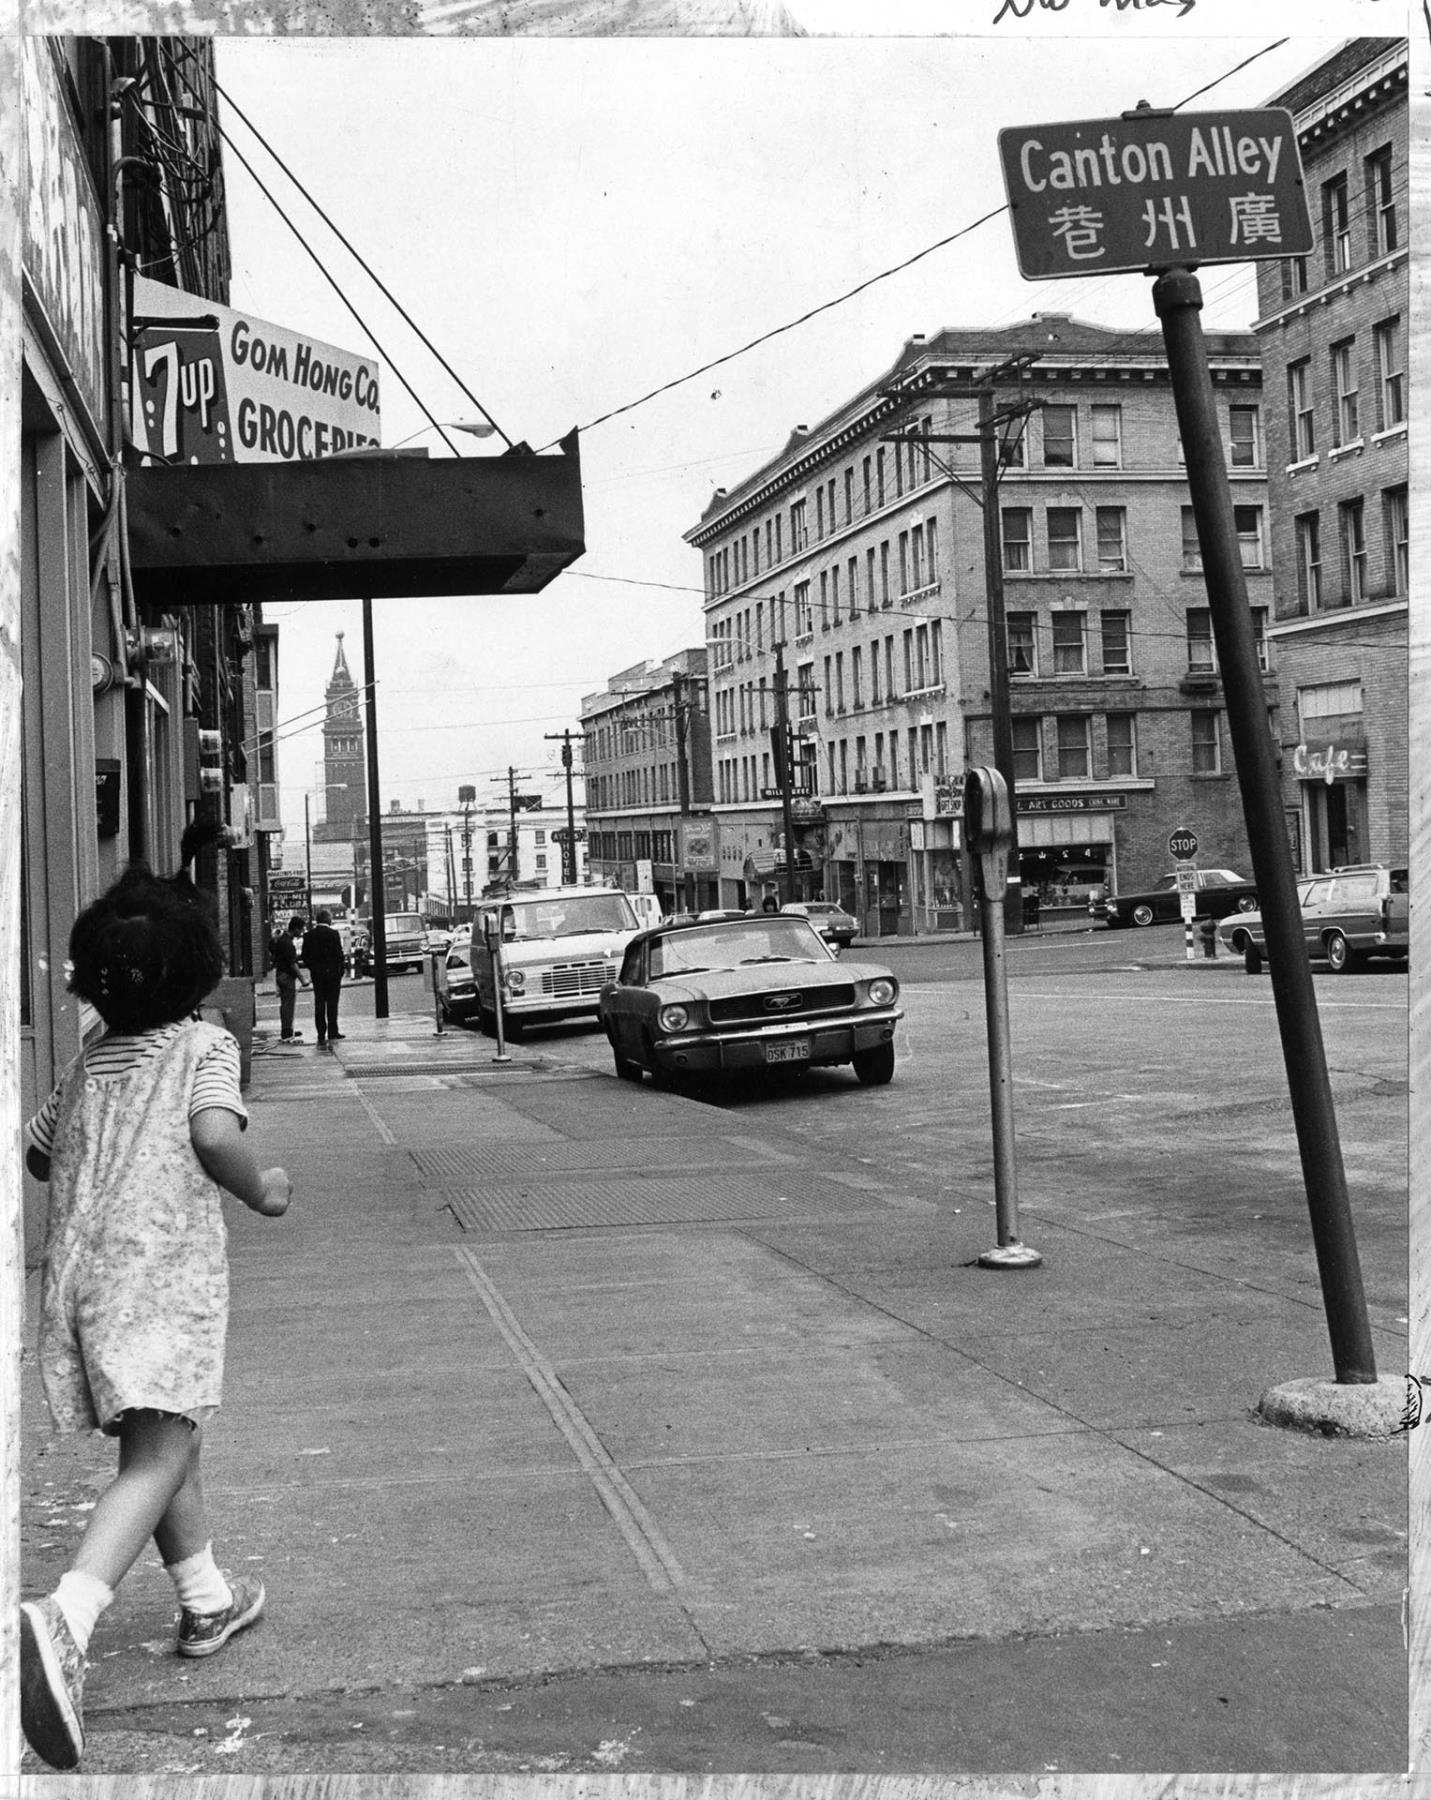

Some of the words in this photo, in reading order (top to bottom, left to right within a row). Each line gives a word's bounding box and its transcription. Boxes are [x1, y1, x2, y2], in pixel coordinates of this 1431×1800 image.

[1020, 134, 1174, 193] Canton
[1188, 126, 1283, 184] Alley
[1051, 798, 1085, 809] GOODS
[552, 832, 579, 841] ATLS
[1170, 838, 1197, 852] STOP
[562, 842, 570, 884] HOTEL
[789, 1045, 809, 1058] 715
